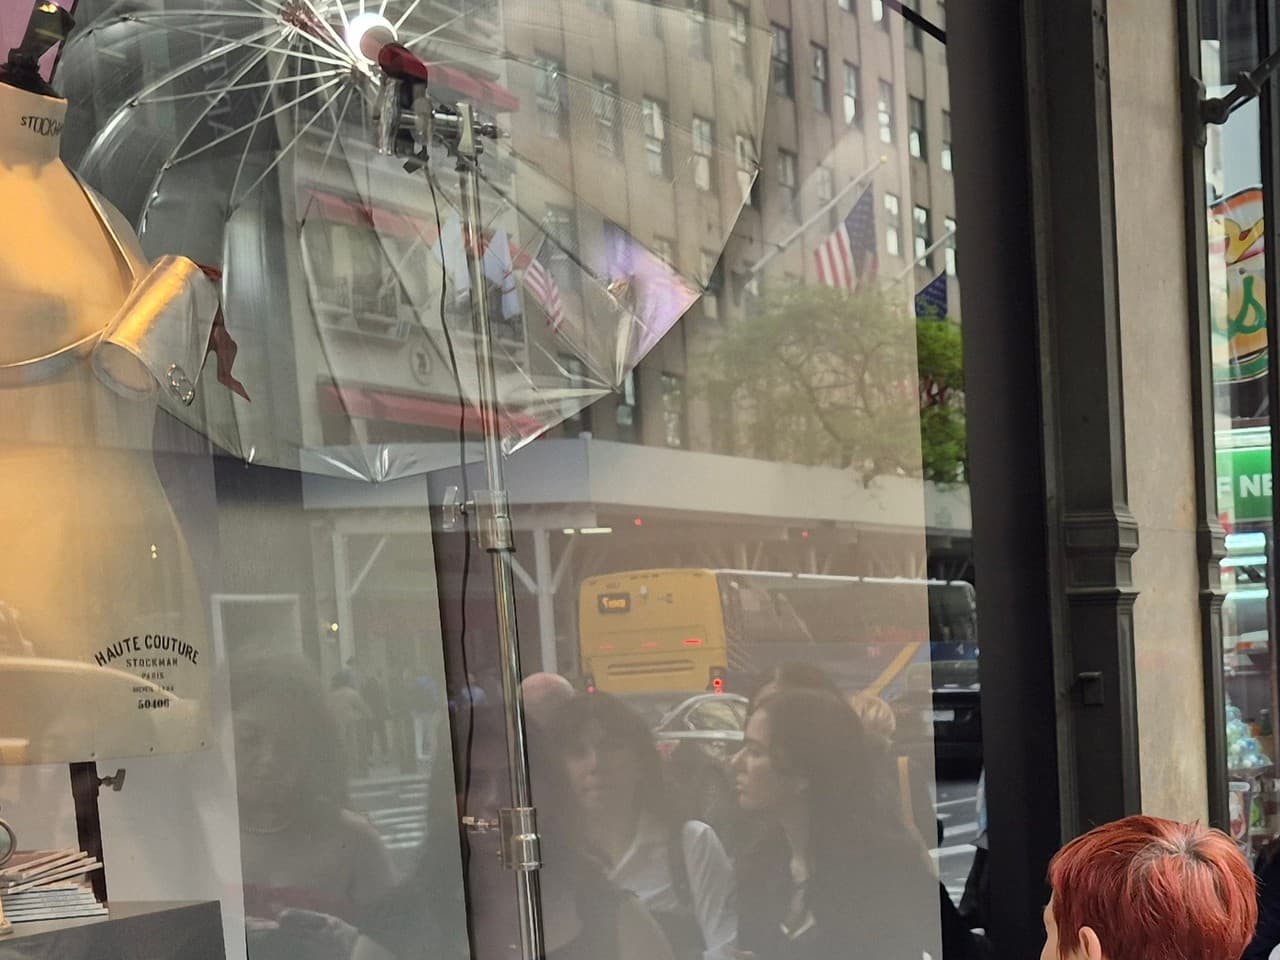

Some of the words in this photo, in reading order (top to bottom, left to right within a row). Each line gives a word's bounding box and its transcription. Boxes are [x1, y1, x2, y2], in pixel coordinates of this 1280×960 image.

[1240, 473, 1272, 498] NE
[94, 636, 141, 667] HAUTE
[144, 634, 199, 665] COUTURE
[126, 658, 178, 668] STOCKMAN
